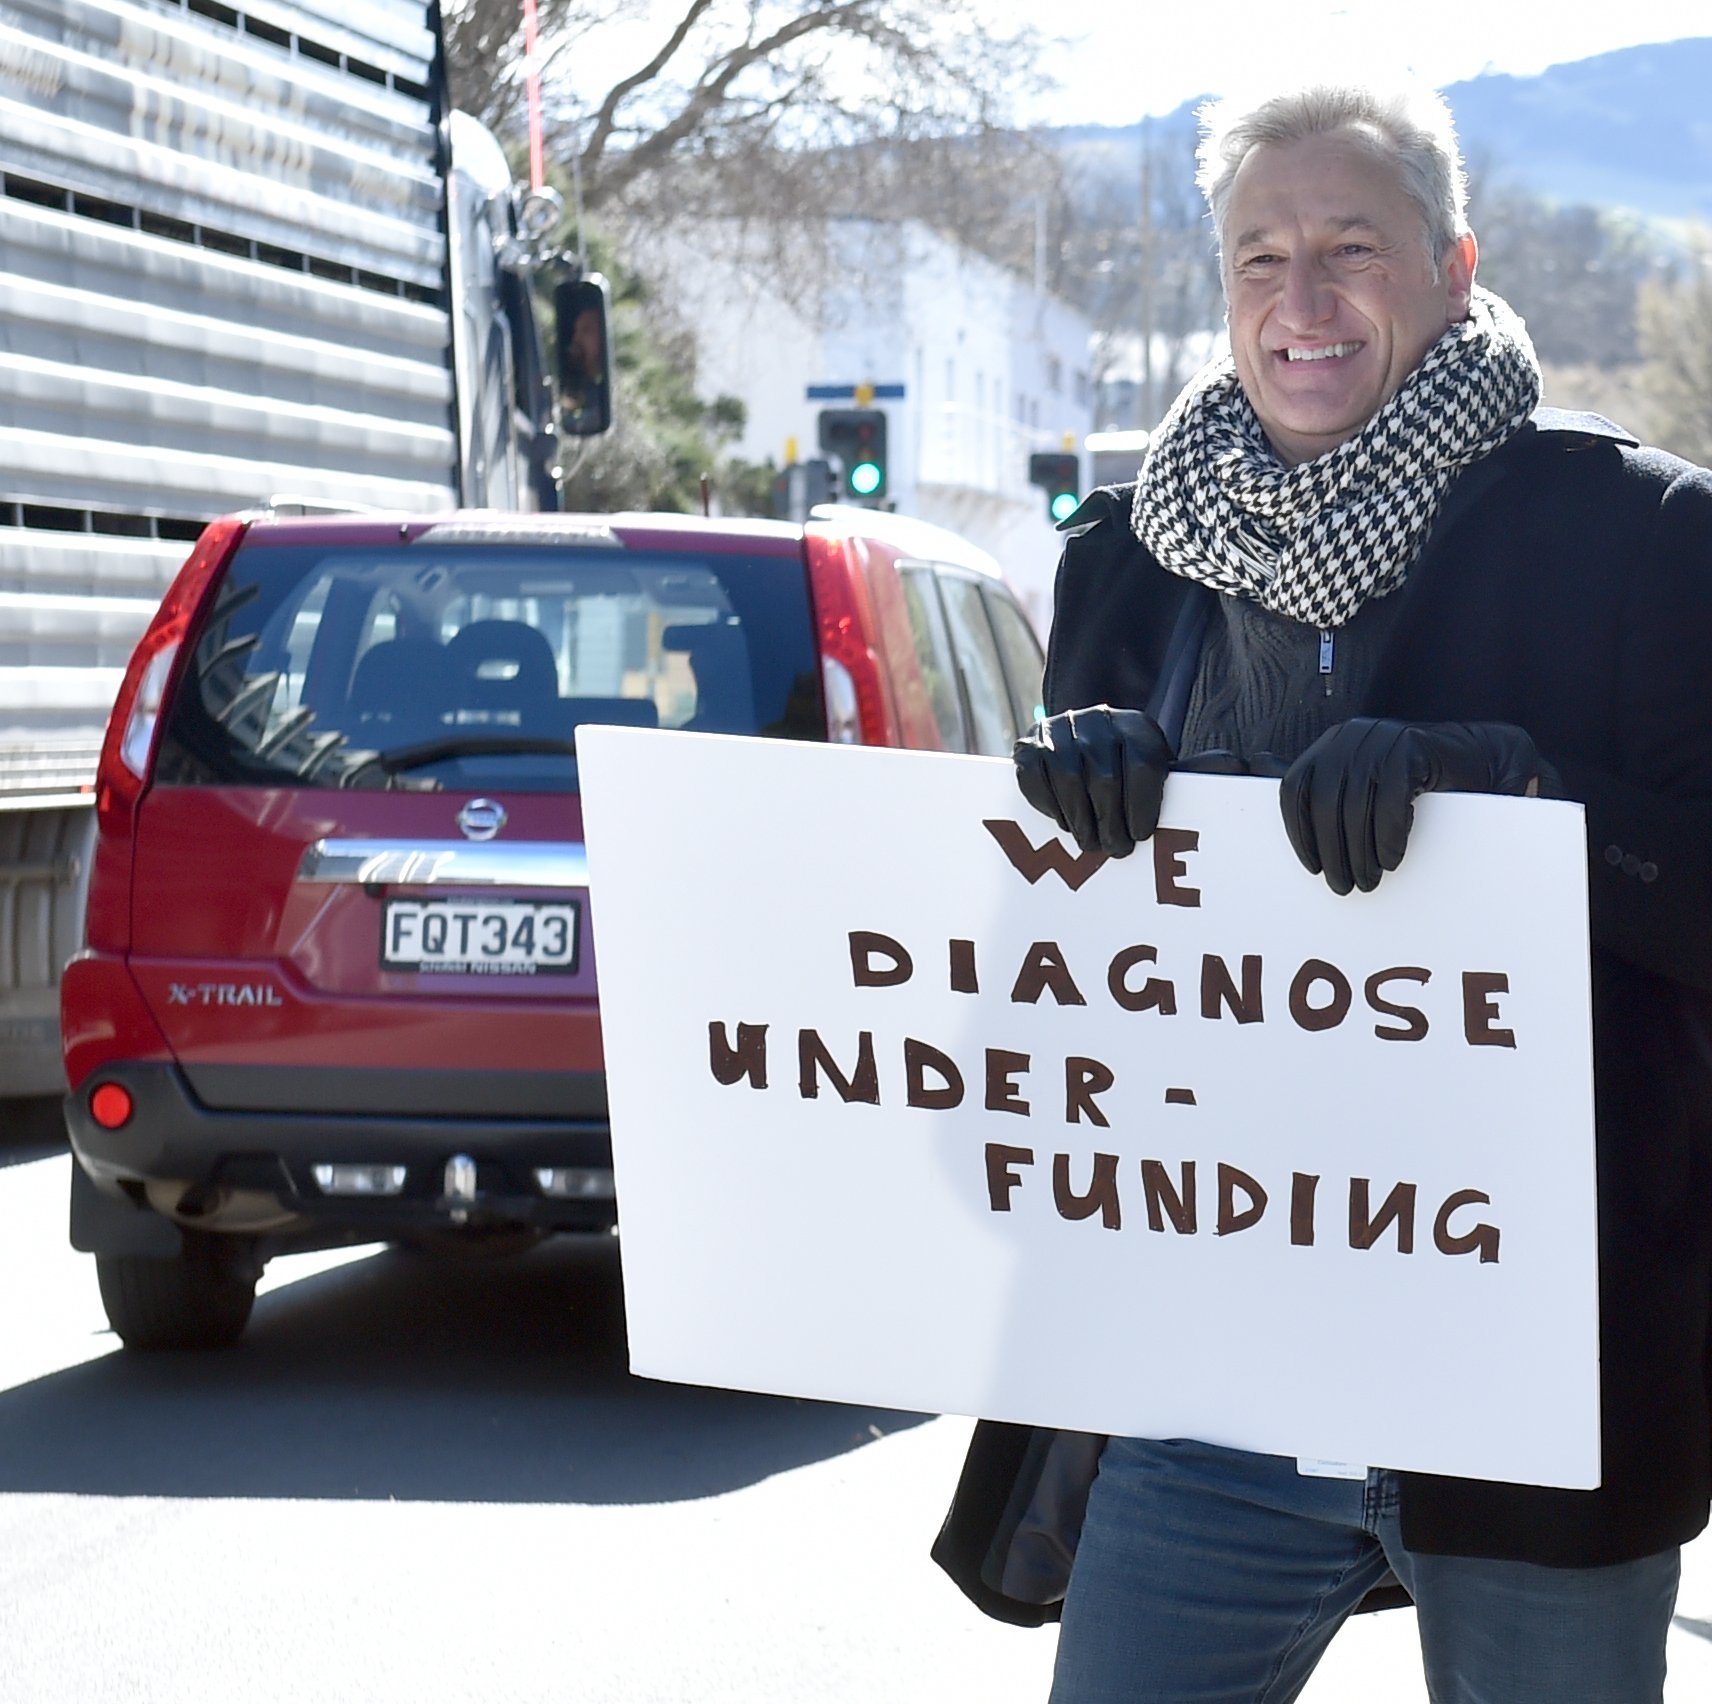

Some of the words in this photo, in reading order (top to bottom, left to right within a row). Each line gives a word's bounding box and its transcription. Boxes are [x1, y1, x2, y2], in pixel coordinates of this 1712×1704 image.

[982, 819, 1201, 908] WE
[392, 912, 568, 957] FQT343
[167, 982, 283, 1006] X-TRAIL
[848, 931, 1517, 1049] DIAGNOSE
[985, 1143, 1500, 1263] FUNDING
